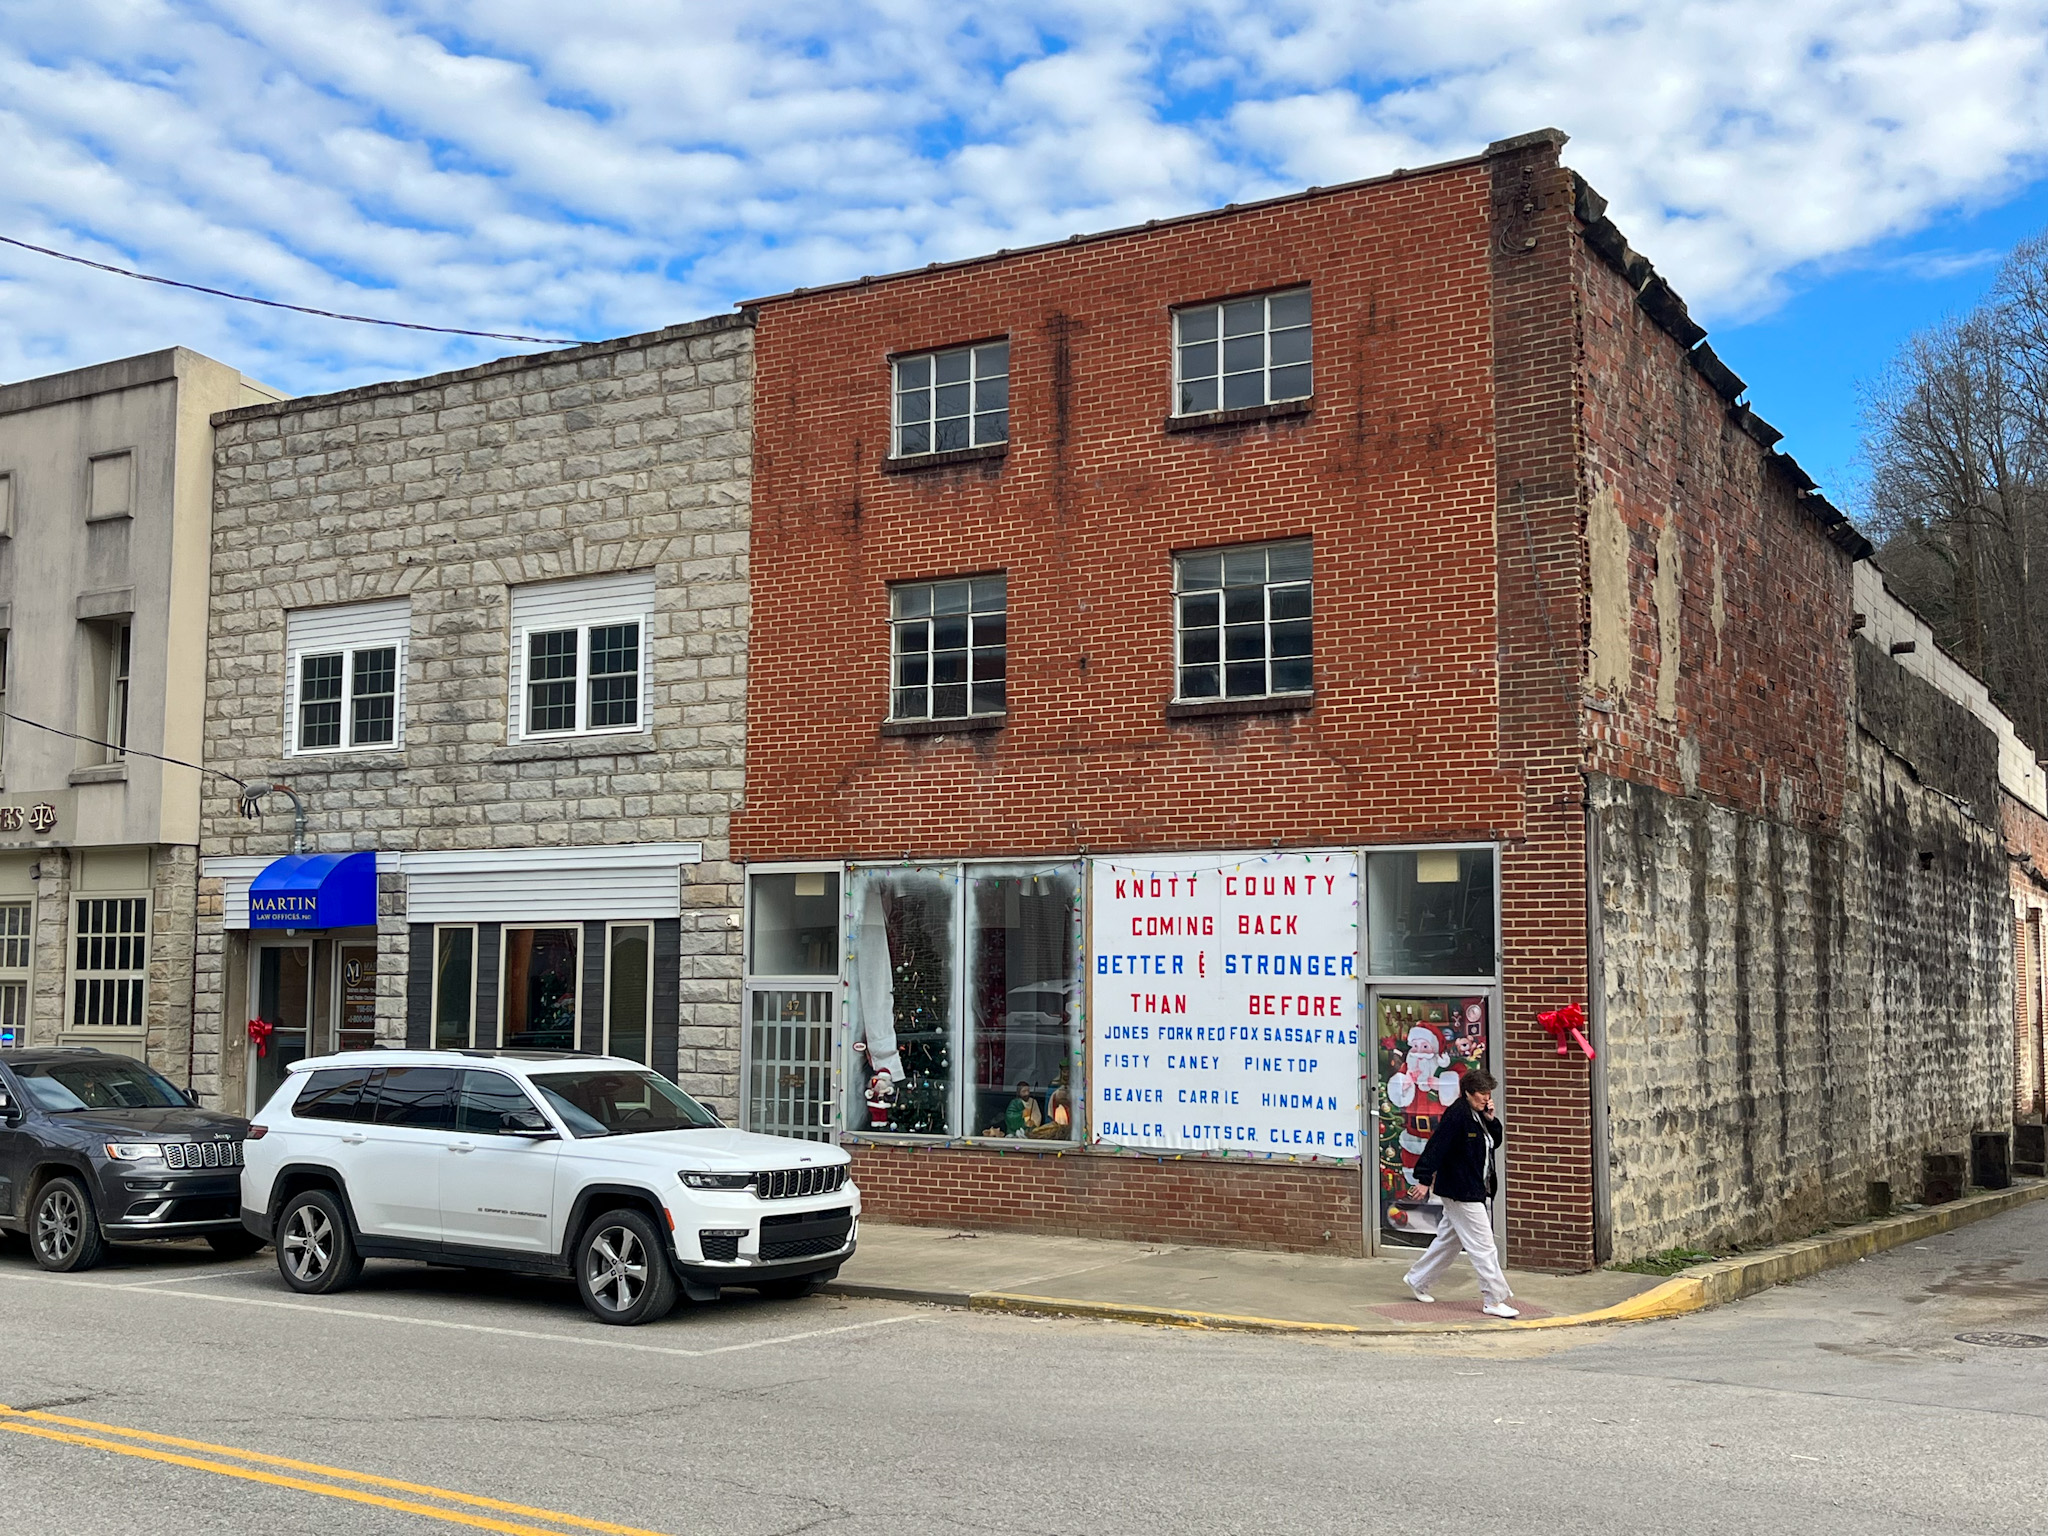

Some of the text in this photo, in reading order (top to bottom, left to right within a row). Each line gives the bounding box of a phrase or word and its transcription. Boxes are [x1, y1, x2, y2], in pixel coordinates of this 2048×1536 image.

[1115, 875, 1335, 899] KNOTT COUNTY
[251, 896, 316, 910] MARTIN
[1132, 914, 1298, 936] COMING BACK
[1097, 954, 1184, 975] BETTER
[1225, 953, 1354, 977] STRONGER
[786, 999, 800, 1011] 47
[1131, 993, 1342, 1017] THAN BEFORE
[1104, 1026, 1149, 1040] JONES
[1158, 1026, 1193, 1041] FORK
[1230, 1026, 1258, 1041] FOX
[1263, 1026, 1358, 1045] SASSAFRAS
[1104, 1053, 1318, 1073] FISTY CANEY PINETOP
[1103, 1087, 1163, 1102] BEAVER
[1178, 1088, 1239, 1105] CARRIE
[1269, 1128, 1326, 1145] CLEAR
